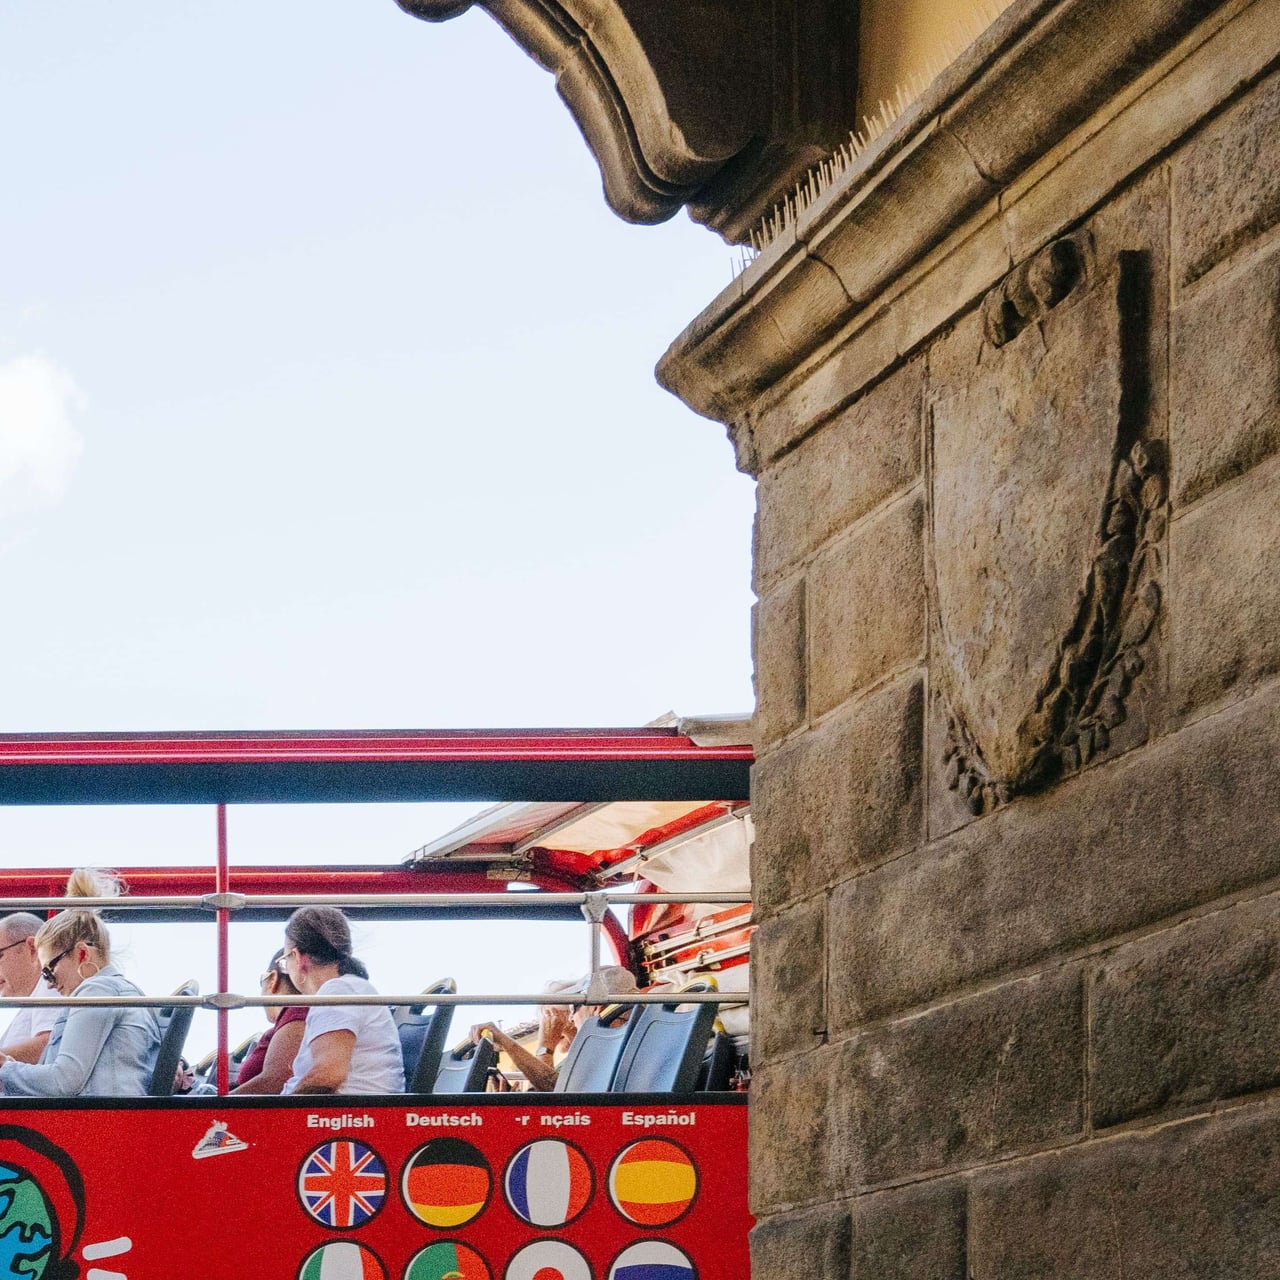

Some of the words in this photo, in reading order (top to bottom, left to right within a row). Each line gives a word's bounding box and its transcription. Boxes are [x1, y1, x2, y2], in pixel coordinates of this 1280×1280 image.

[306, 1113, 375, 1131] English
[405, 1112, 483, 1127] Deutsch
[515, 1111, 591, 1128] rnçais
[621, 1109, 696, 1128] Español
